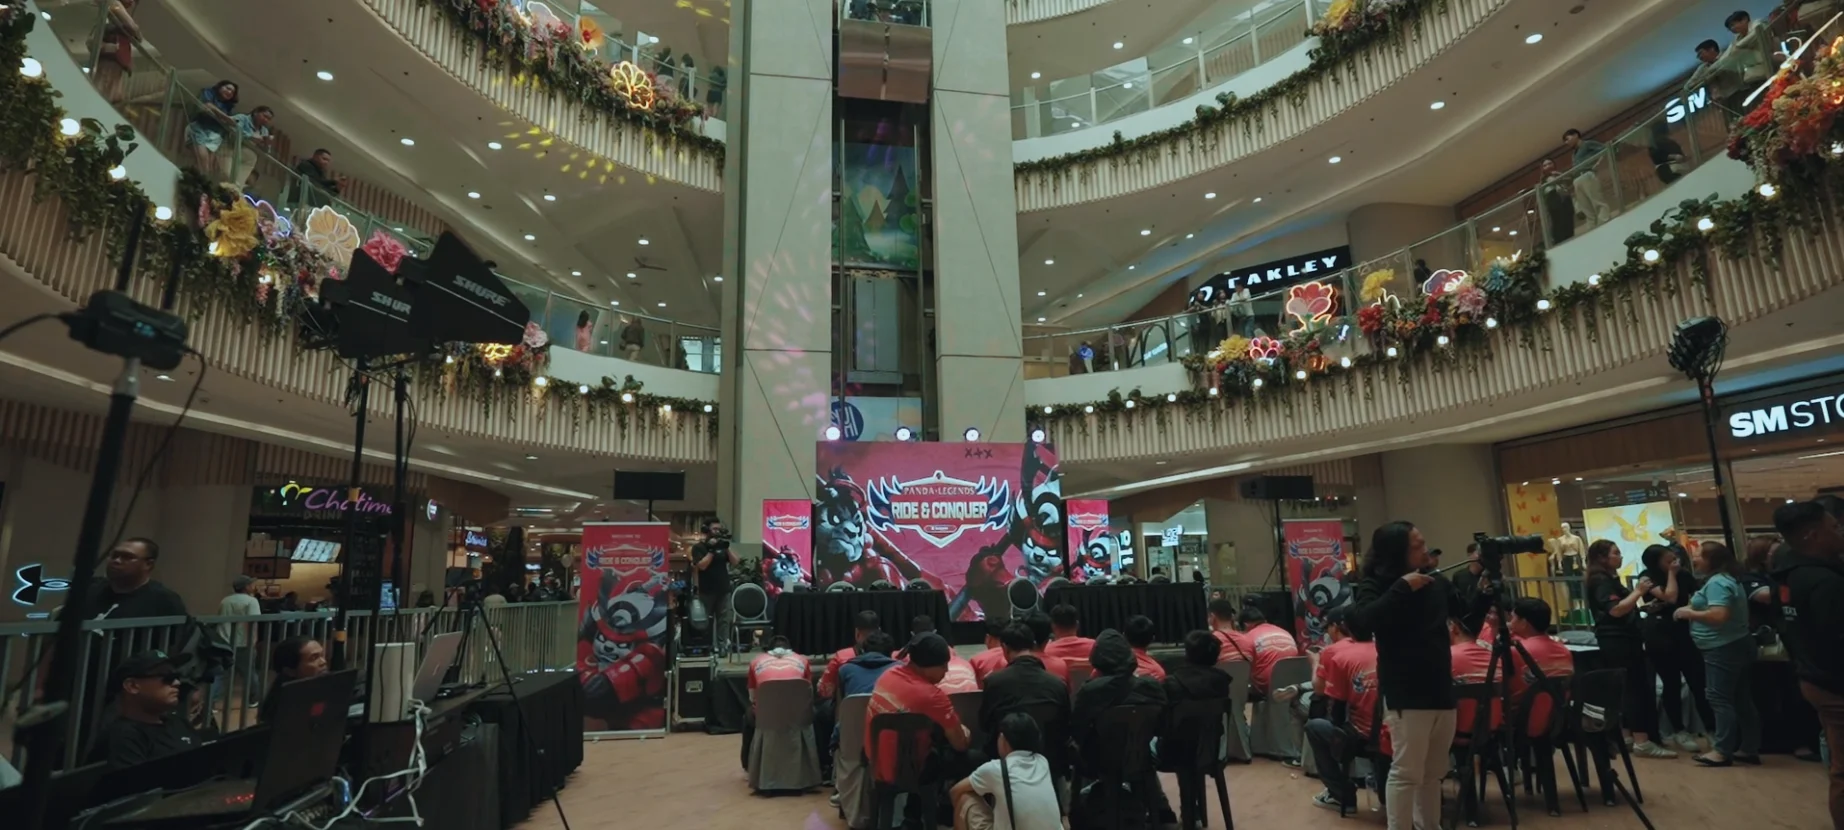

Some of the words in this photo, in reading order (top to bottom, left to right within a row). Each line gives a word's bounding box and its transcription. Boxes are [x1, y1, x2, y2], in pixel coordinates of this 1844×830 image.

[370, 291, 413, 315] SHUR
[452, 275, 507, 307] SHURE
[1729, 405, 1789, 437] SM
[891, 501, 919, 519] RIDE
[921, 502, 930, 519] &
[932, 501, 988, 520] CONQUER
